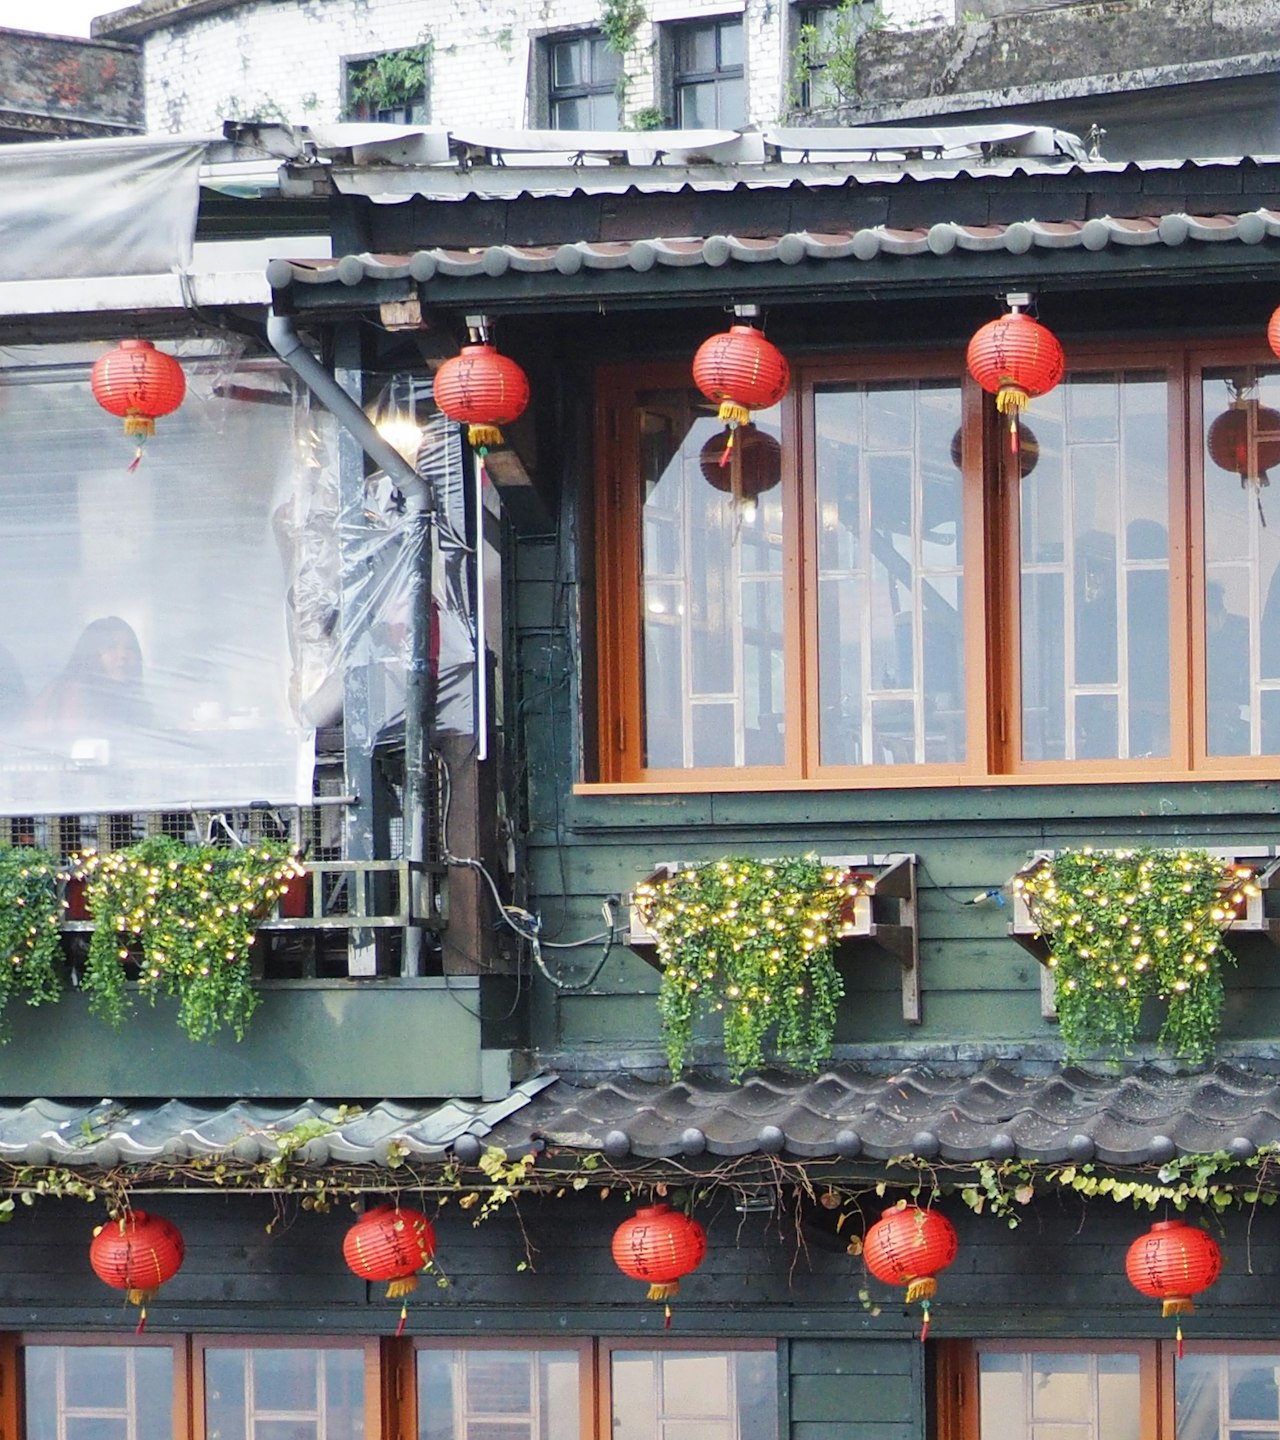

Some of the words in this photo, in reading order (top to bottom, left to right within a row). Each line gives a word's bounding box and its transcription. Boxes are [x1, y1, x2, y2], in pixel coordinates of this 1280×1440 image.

[631, 1226, 651, 1276] 阿妹茶樓
[1145, 1238, 1164, 1289] 阿妹茶樓
